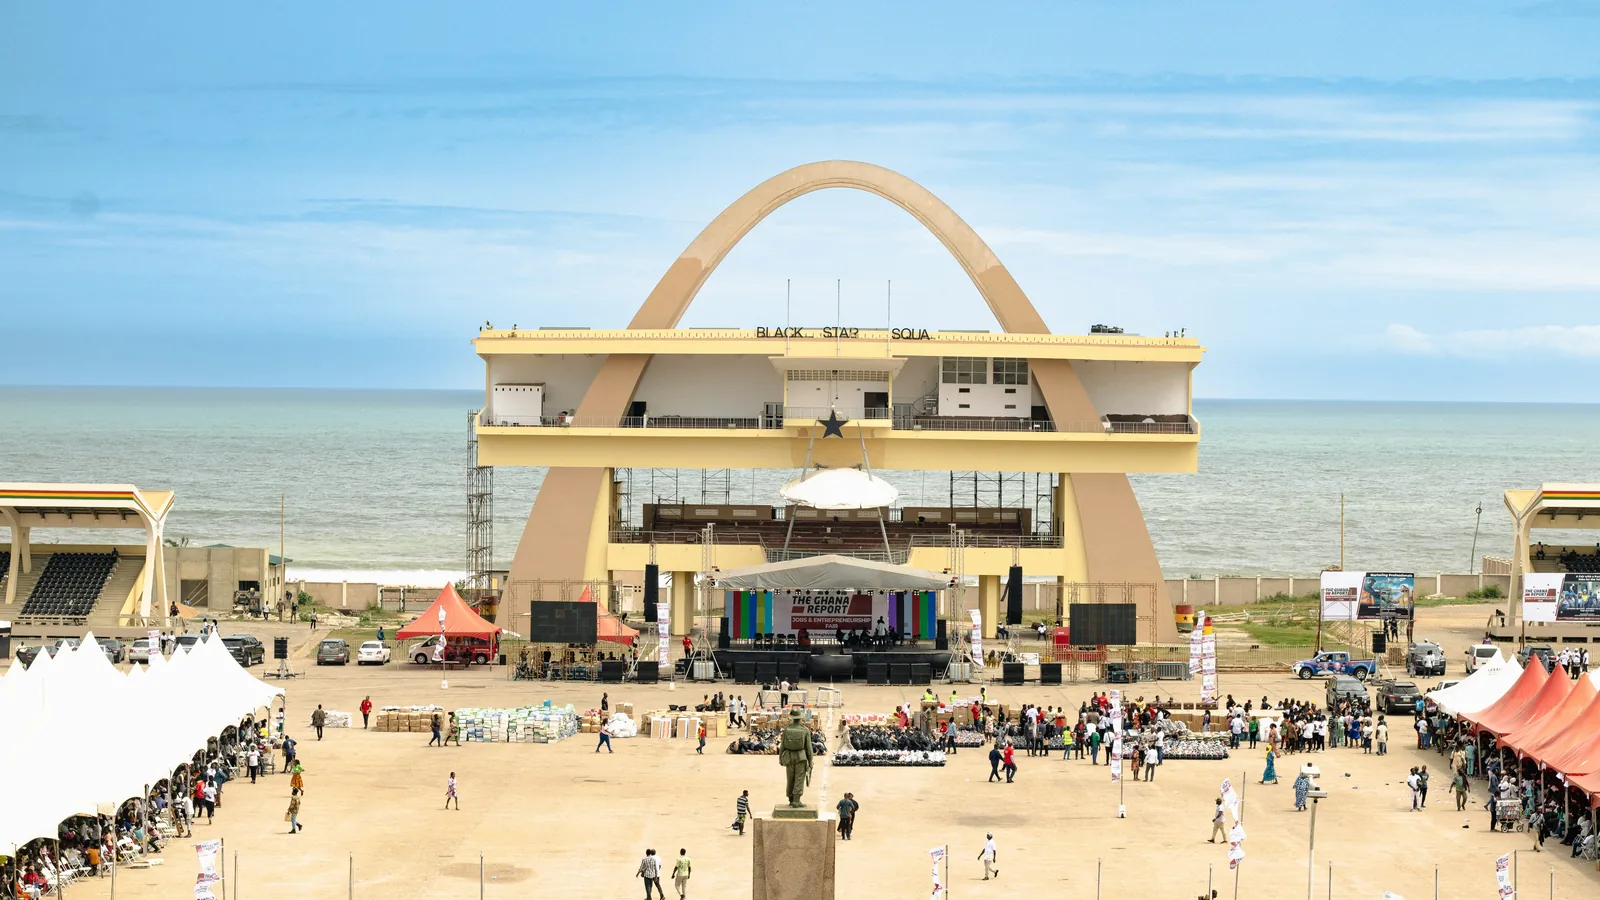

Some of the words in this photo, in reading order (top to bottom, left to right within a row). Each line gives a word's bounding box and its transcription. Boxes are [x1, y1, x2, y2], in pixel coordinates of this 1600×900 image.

[756, 326, 804, 339] BLACK
[891, 327, 931, 340] SQUA
[792, 596, 812, 605] THE
[814, 596, 849, 605] GHANA
[807, 605, 848, 614] REPORT
